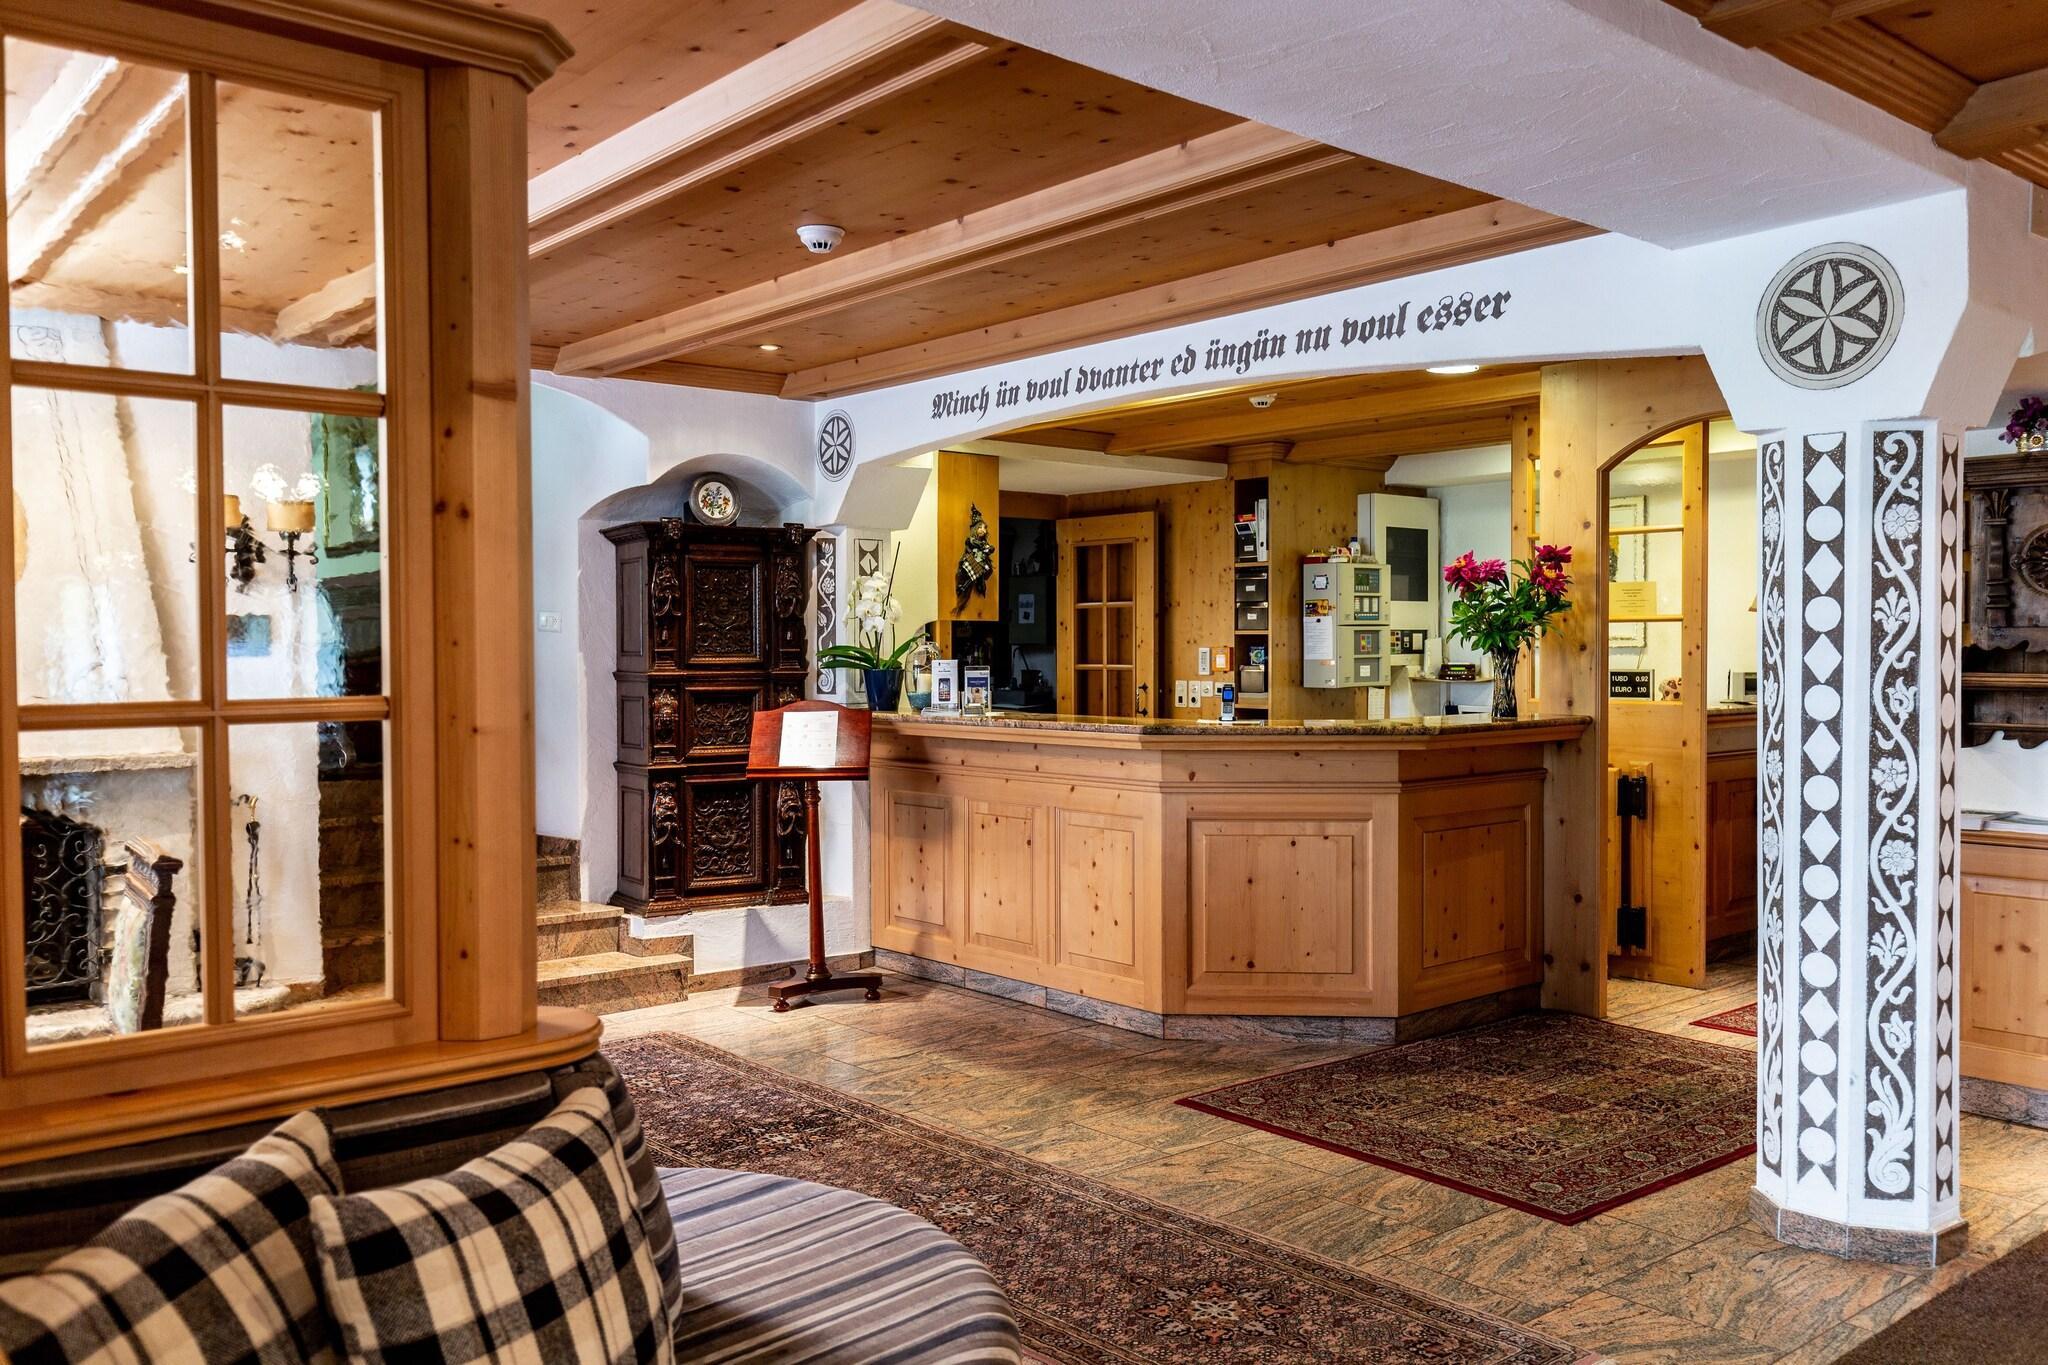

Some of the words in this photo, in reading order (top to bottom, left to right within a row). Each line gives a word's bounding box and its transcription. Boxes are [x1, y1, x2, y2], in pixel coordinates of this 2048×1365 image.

[931, 386, 990, 422] Minch
[995, 380, 1021, 408] ün
[1026, 367, 1072, 402] voul
[1075, 357, 1164, 394] dvanter
[1170, 344, 1197, 377] ed
[1205, 328, 1287, 375] üngün
[1340, 301, 1411, 347] voul
[1417, 291, 1512, 334] esser
